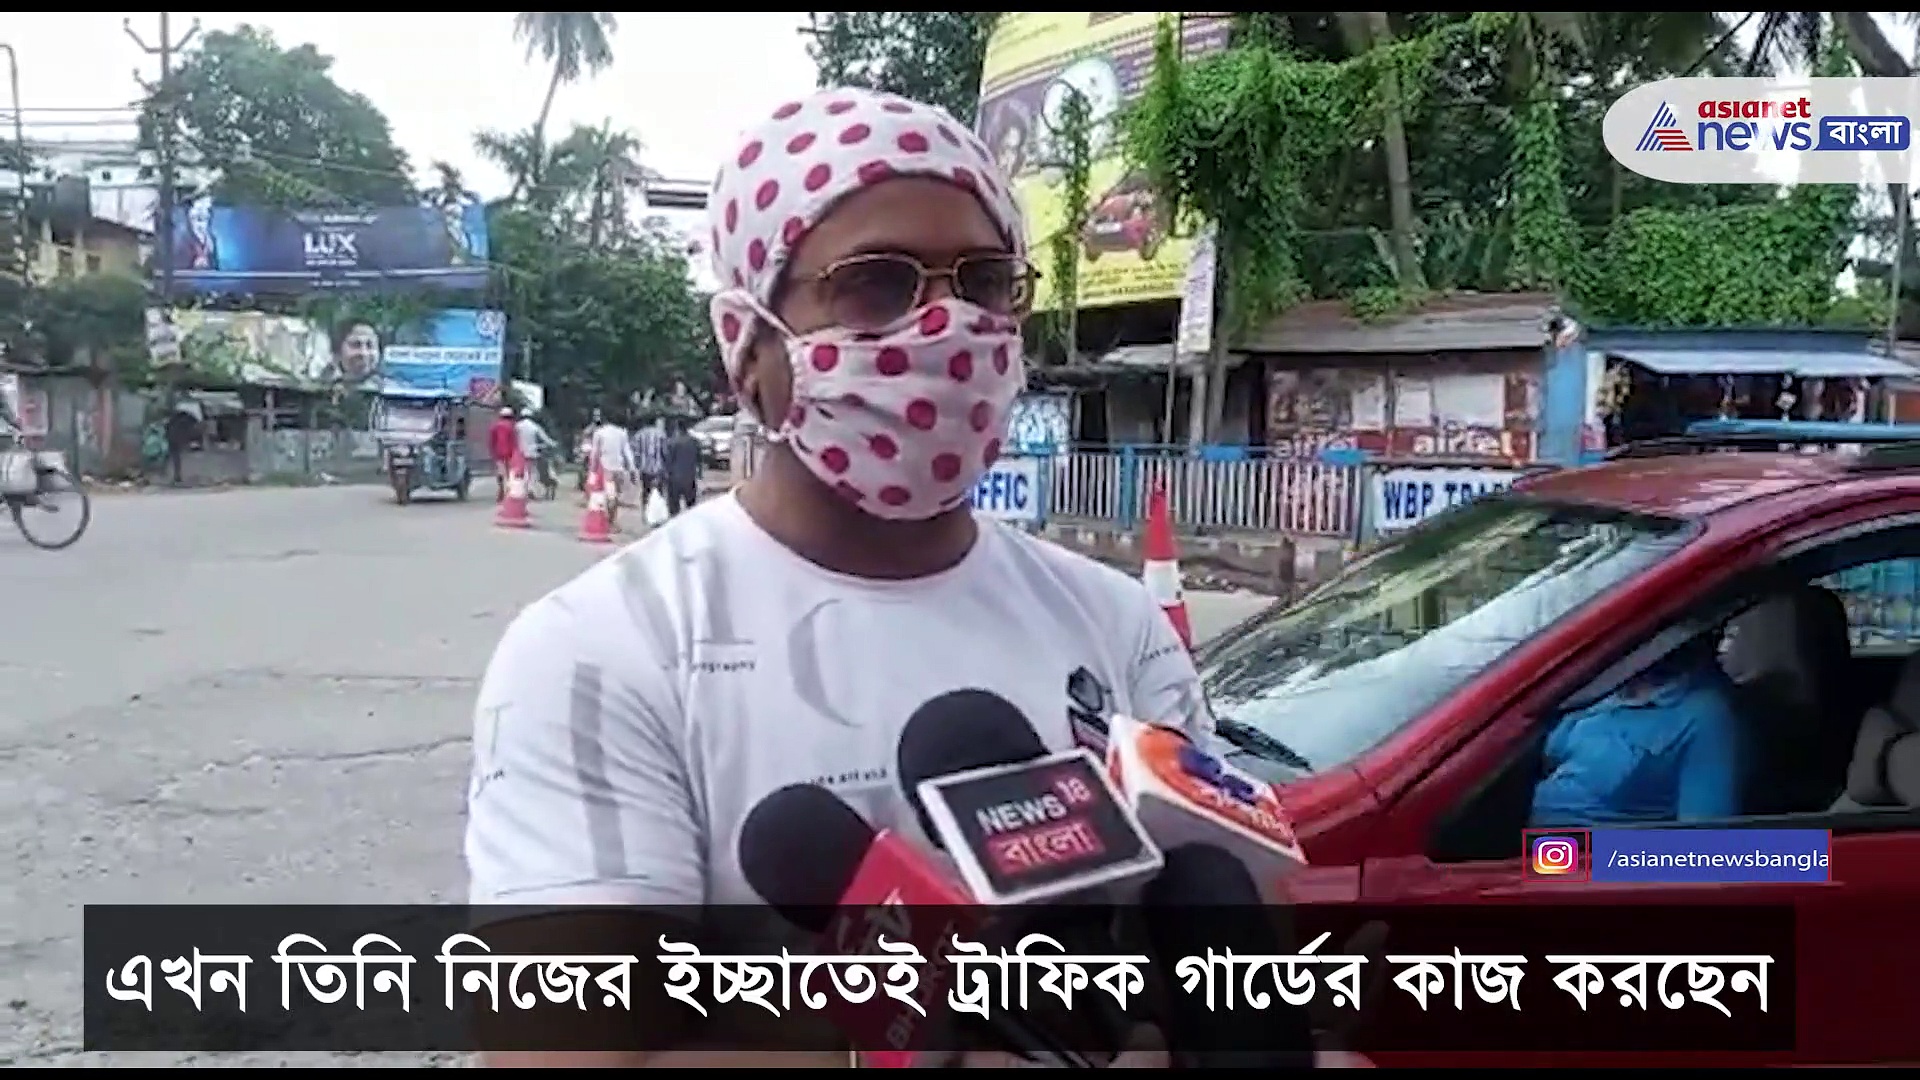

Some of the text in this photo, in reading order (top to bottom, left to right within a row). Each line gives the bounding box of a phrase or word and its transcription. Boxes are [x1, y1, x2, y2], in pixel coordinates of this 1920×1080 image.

[304, 232, 357, 254] LUX
[973, 472, 1029, 510] FFIC
[1384, 481, 1434, 519] WBP
[975, 793, 1068, 836] NEWS
[995, 822, 1096, 867] বাংলা
